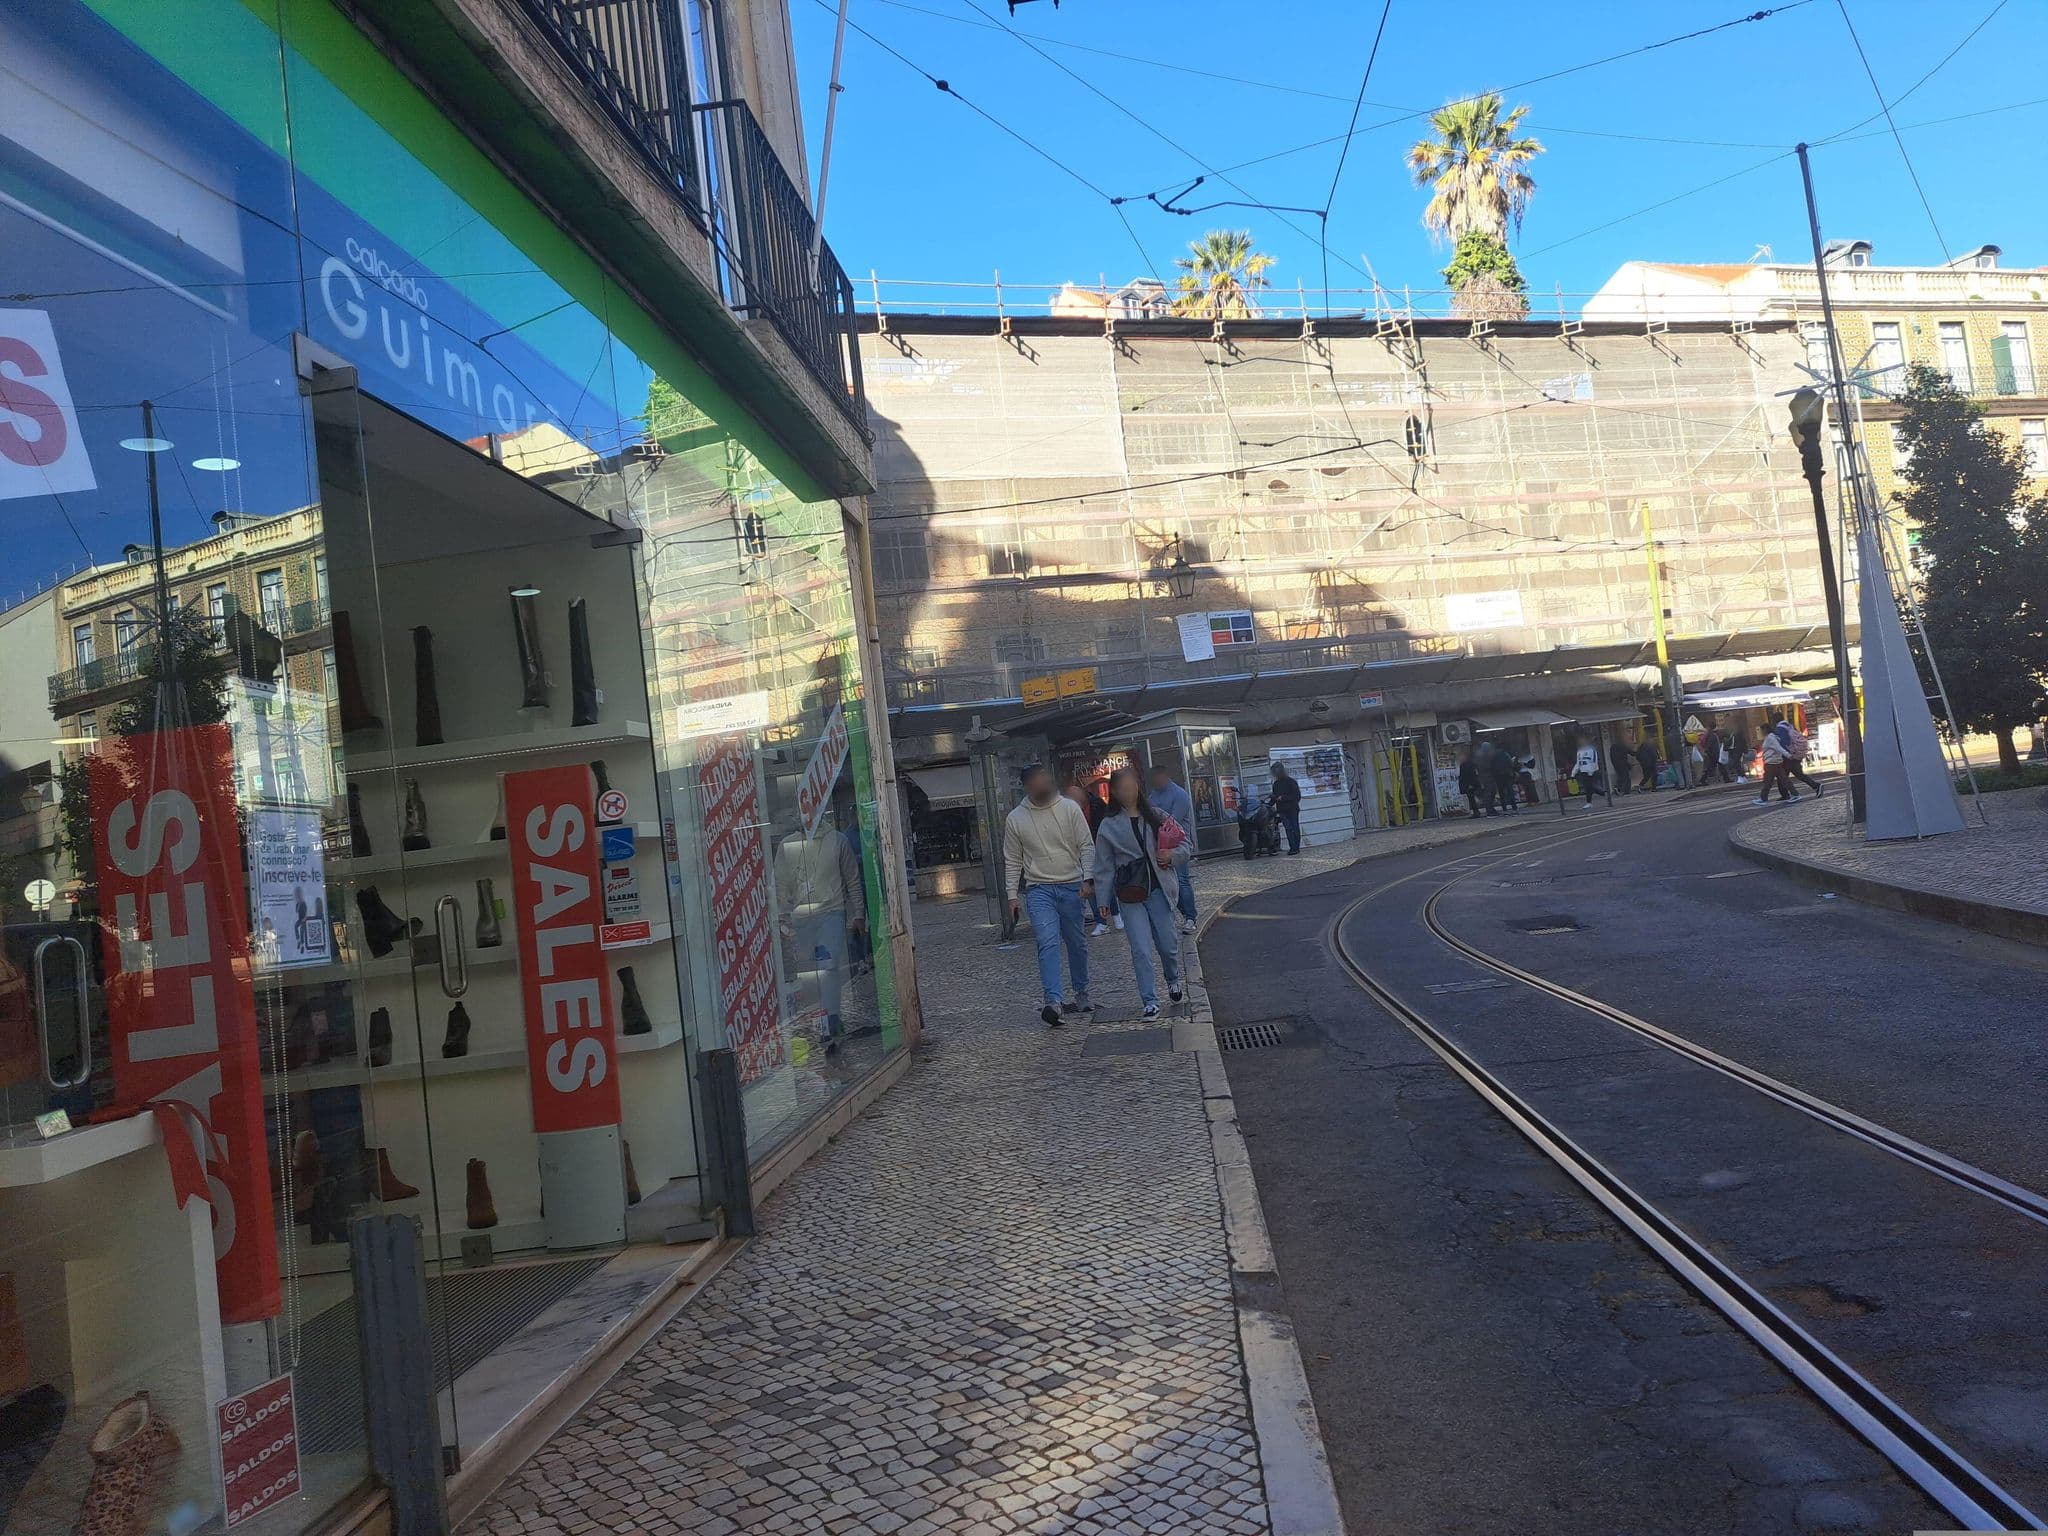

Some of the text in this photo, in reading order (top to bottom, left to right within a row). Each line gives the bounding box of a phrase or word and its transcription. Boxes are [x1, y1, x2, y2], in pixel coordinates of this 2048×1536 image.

[345, 237, 429, 312] calçado
[800, 712, 845, 832] SALDOS
[261, 855, 307, 866] connosco?
[274, 843, 310, 855] trabhar
[713, 812, 754, 885] SALDOS
[261, 870, 322, 883] Inscreve-te
[525, 803, 607, 1093] SALES
[221, 1393, 291, 1444] SALDOS
[225, 1432, 295, 1485] SALDOS
[228, 1469, 298, 1525] SALDOS
